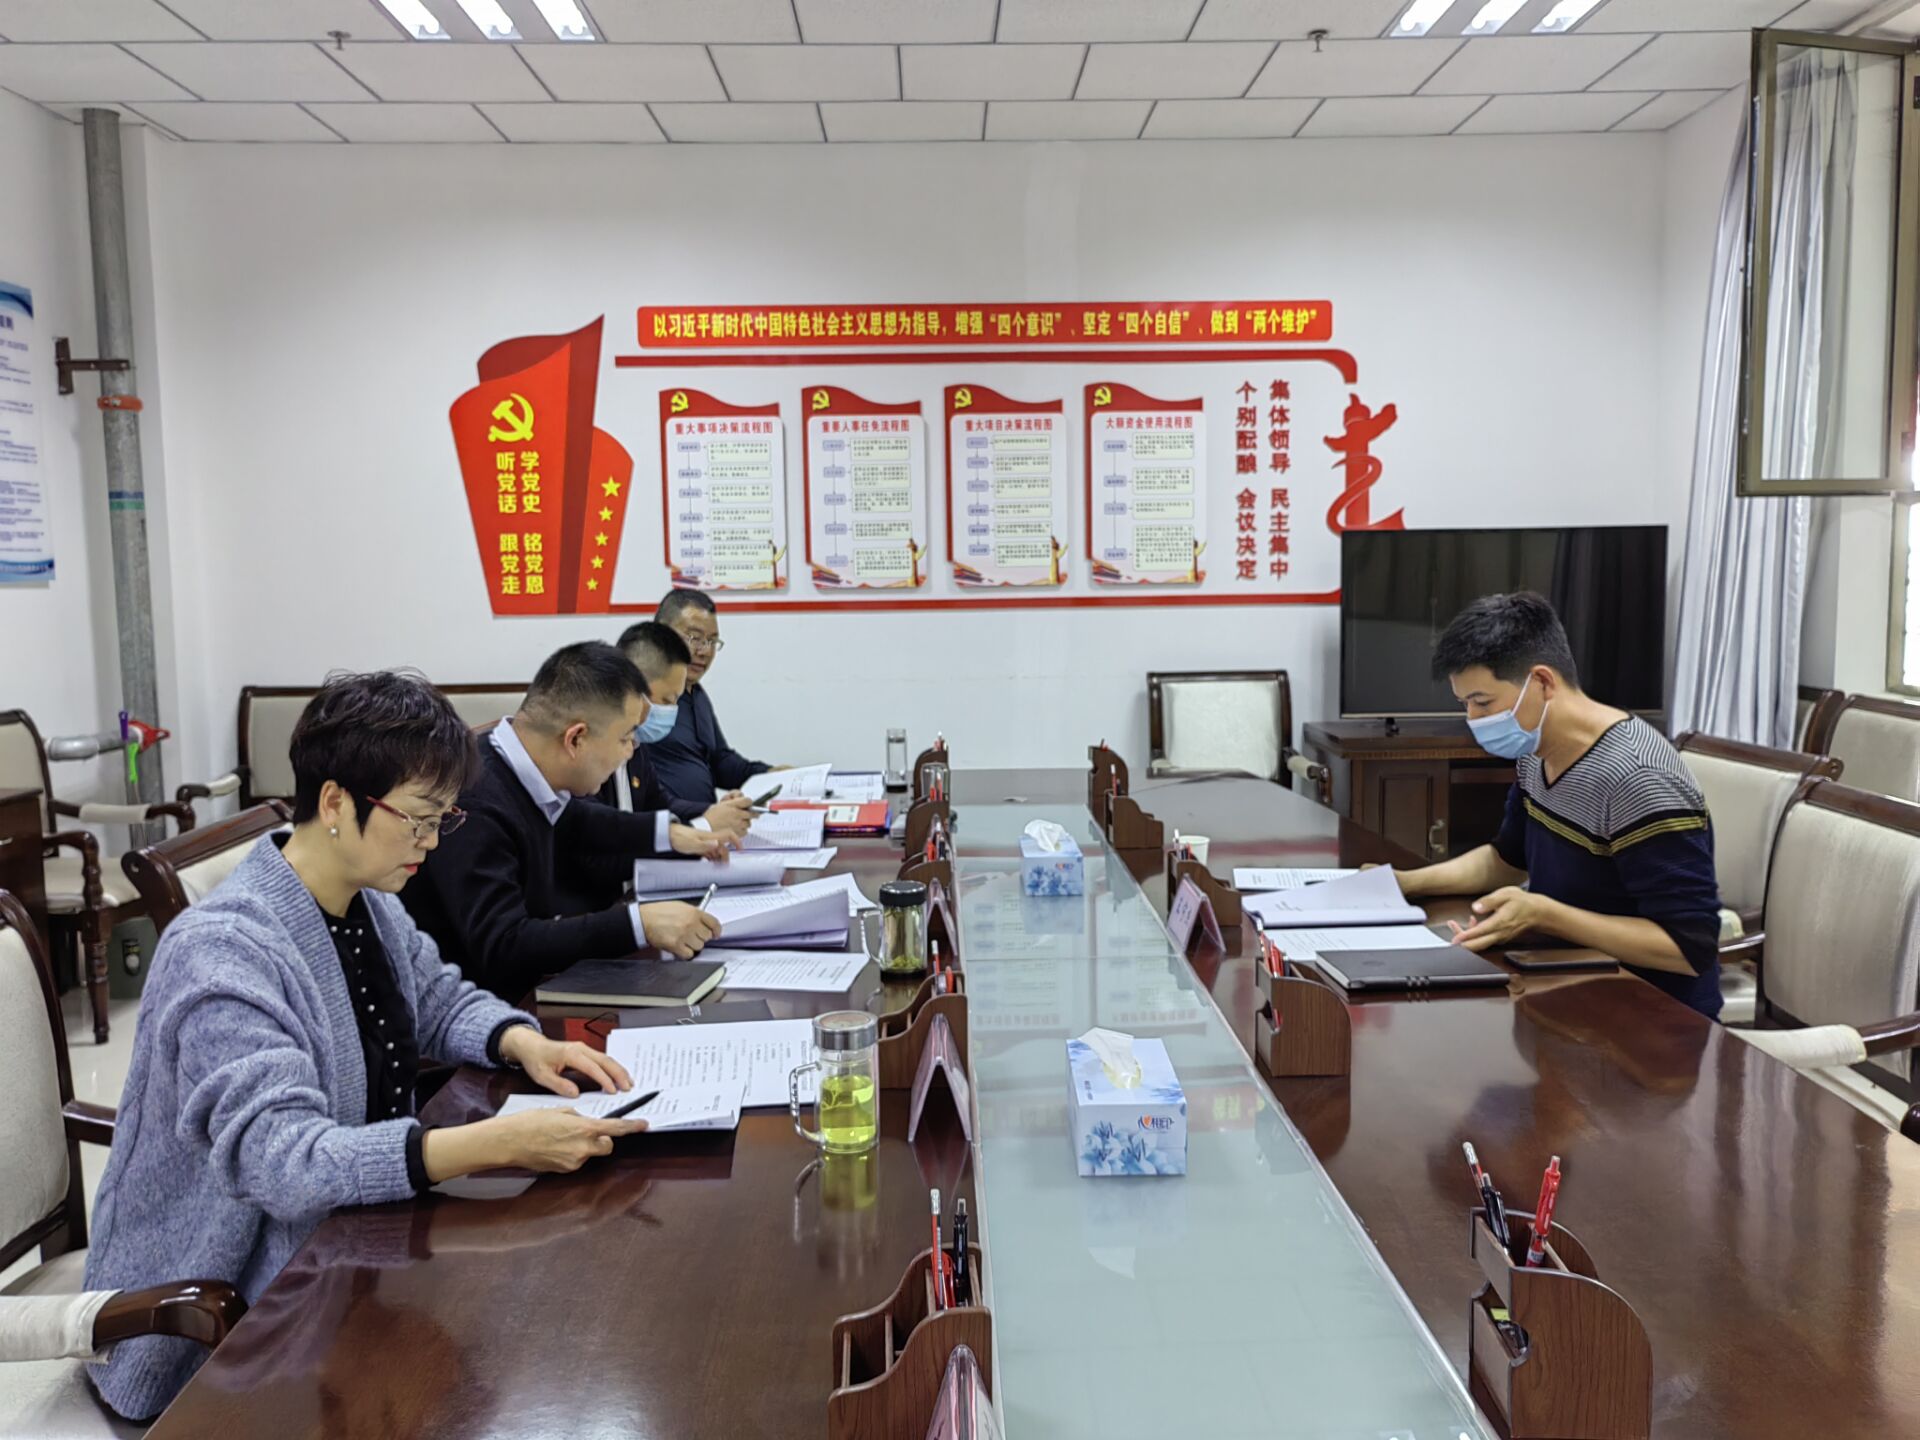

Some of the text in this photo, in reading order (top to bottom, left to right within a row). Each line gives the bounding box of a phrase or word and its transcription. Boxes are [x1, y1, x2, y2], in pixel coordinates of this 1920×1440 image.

[674, 421, 773, 435] 重大事项决策流程图
[821, 419, 910, 433] 重要人事任免流程图
[965, 418, 1053, 432] 重大项目决策流程图
[1105, 416, 1194, 429] 大额资金使用流程图
[1236, 380, 1257, 580] 个别酝酿 会议决定
[1269, 379, 1290, 581] 集体领导 民主集中
[495, 452, 521, 594] 听党话 跟党走
[520, 451, 545, 594] 学党史 铭党恩
